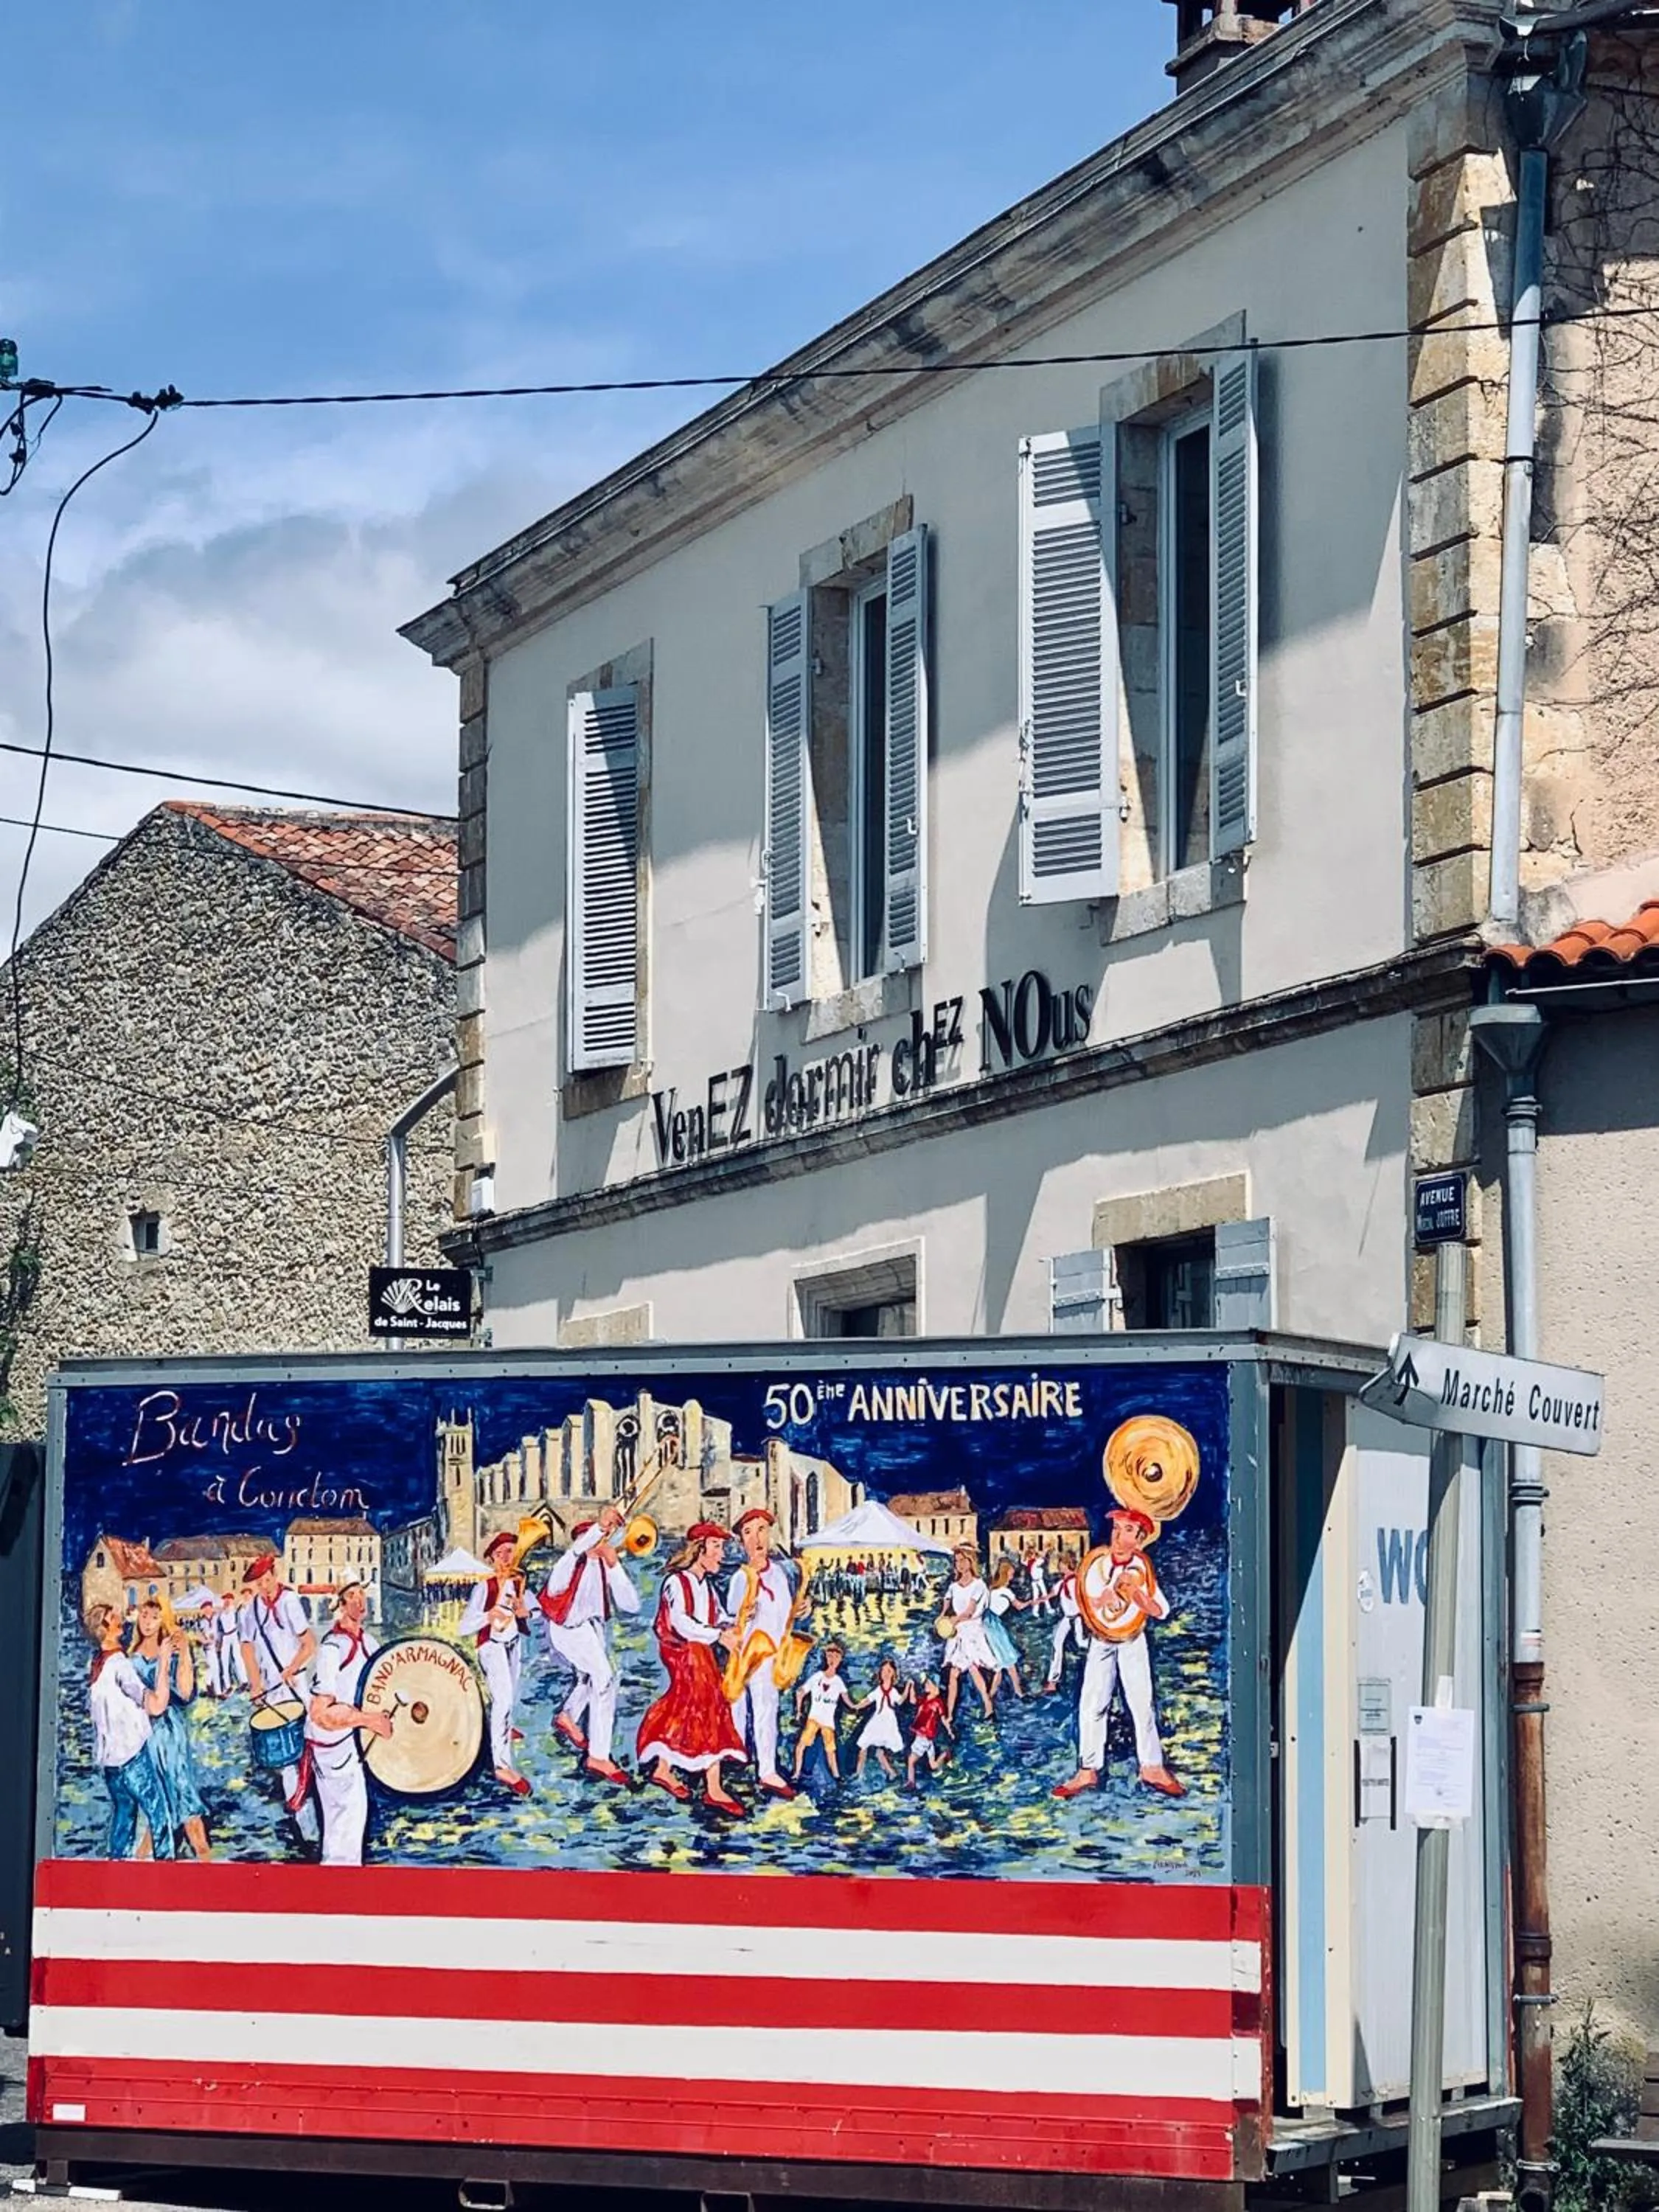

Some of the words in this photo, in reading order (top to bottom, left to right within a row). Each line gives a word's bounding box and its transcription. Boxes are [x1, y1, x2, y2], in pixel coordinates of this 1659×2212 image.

[1419, 1186, 1455, 1207] AVENUE
[425, 1279, 441, 1291] Le
[394, 1278, 461, 1315] Relais
[374, 1316, 389, 1327] de
[1440, 1368, 1516, 1417] Marché
[1528, 1384, 1601, 1432] Couvert
